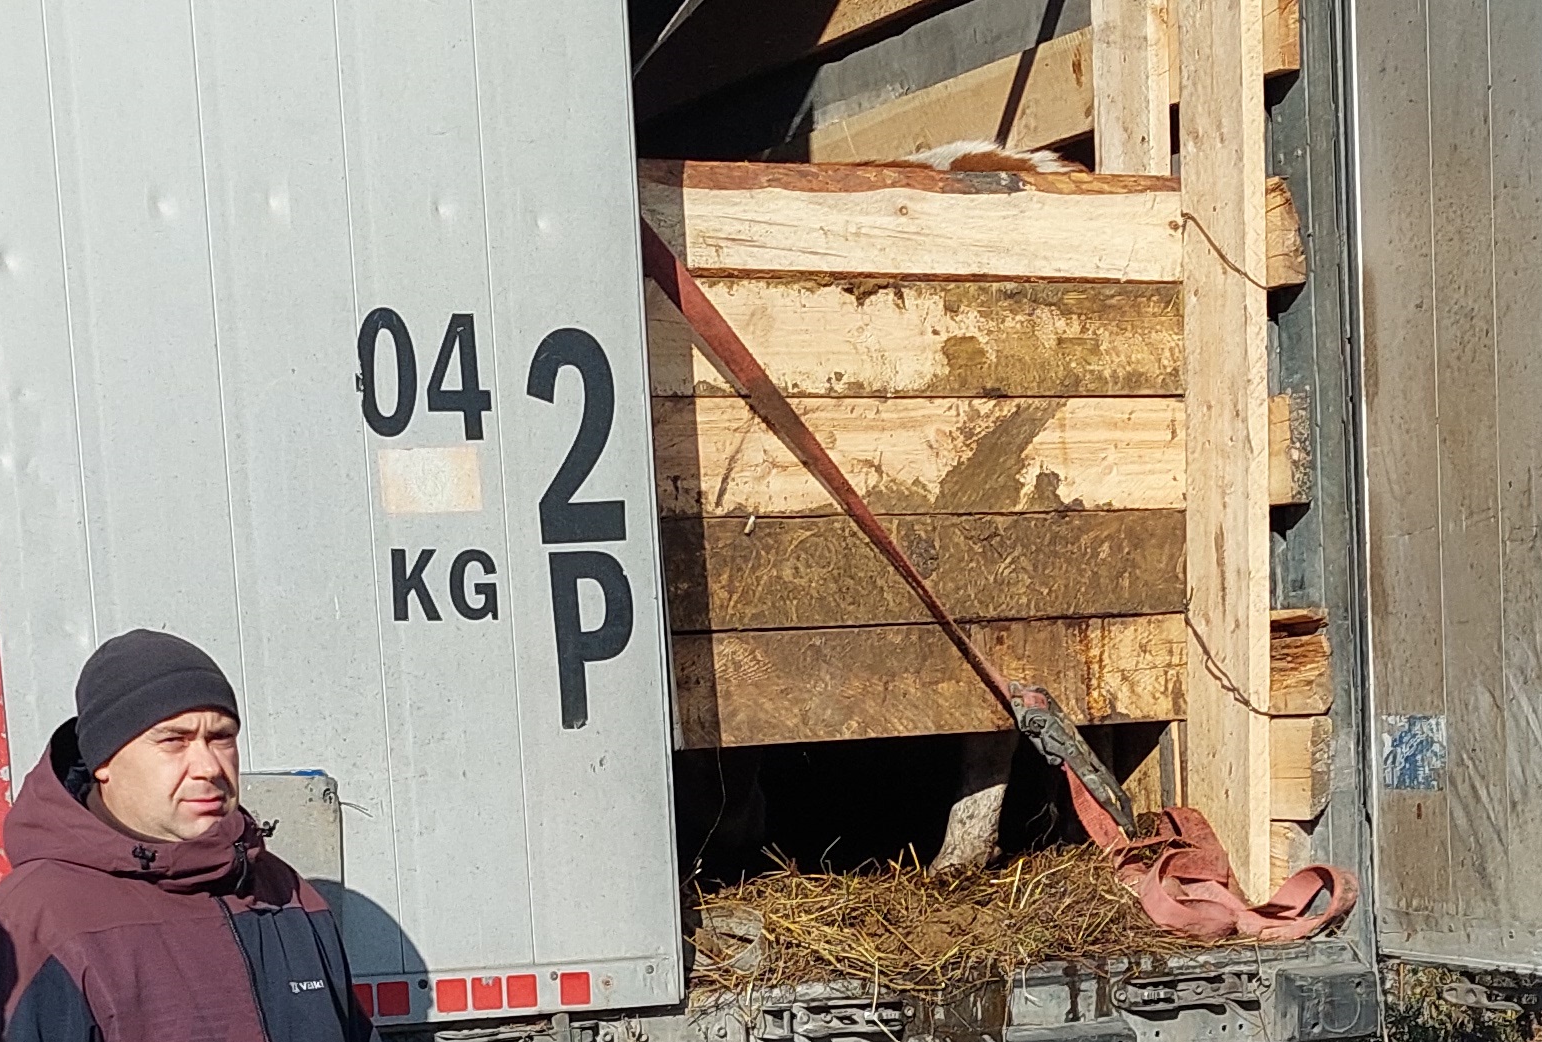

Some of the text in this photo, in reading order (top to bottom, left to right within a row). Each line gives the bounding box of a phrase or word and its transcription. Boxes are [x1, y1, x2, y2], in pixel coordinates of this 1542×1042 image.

[356, 306, 492, 441] 04
[526, 327, 627, 545] 2
[390, 547, 499, 622] KG
[548, 550, 634, 730] P
